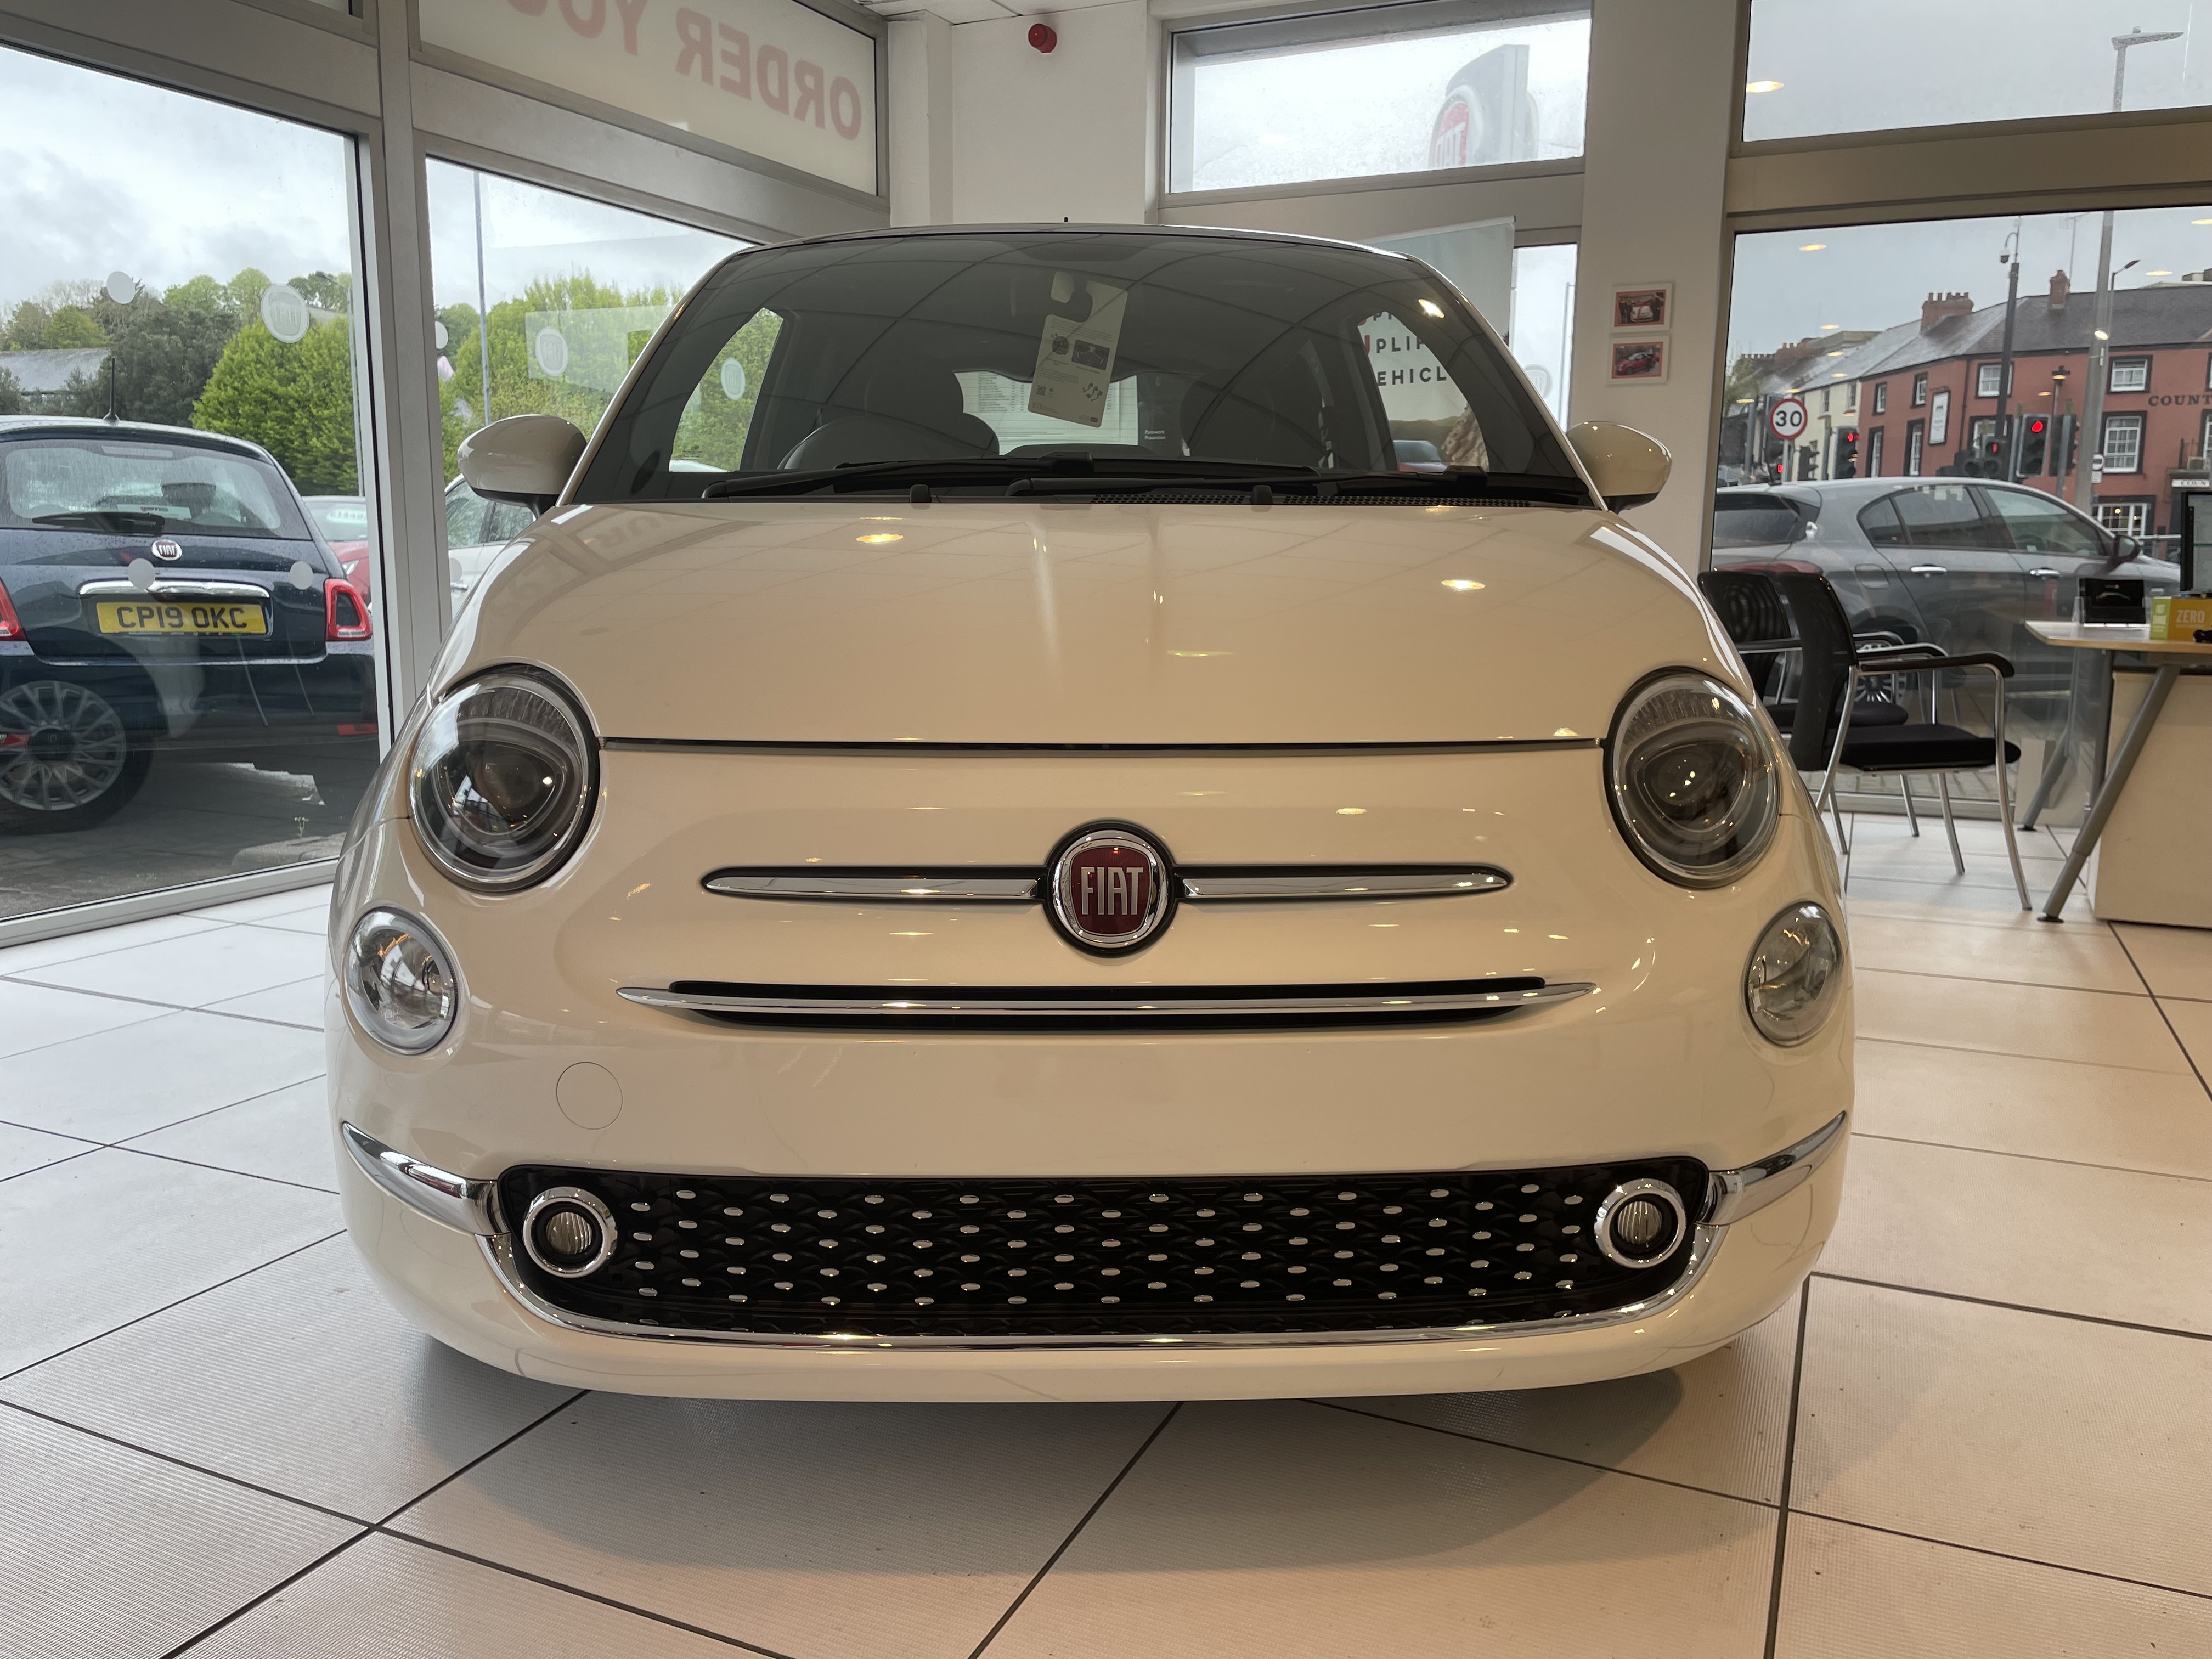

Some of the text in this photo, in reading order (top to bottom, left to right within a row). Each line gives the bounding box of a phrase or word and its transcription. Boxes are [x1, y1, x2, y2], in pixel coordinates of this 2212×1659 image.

[1775, 410, 1802, 427] 30
[158, 545, 176, 556] FIAT
[116, 606, 247, 629] CP19 OKC
[2175, 609, 2205, 624] ZERO
[1081, 866, 1144, 915] FIAT
